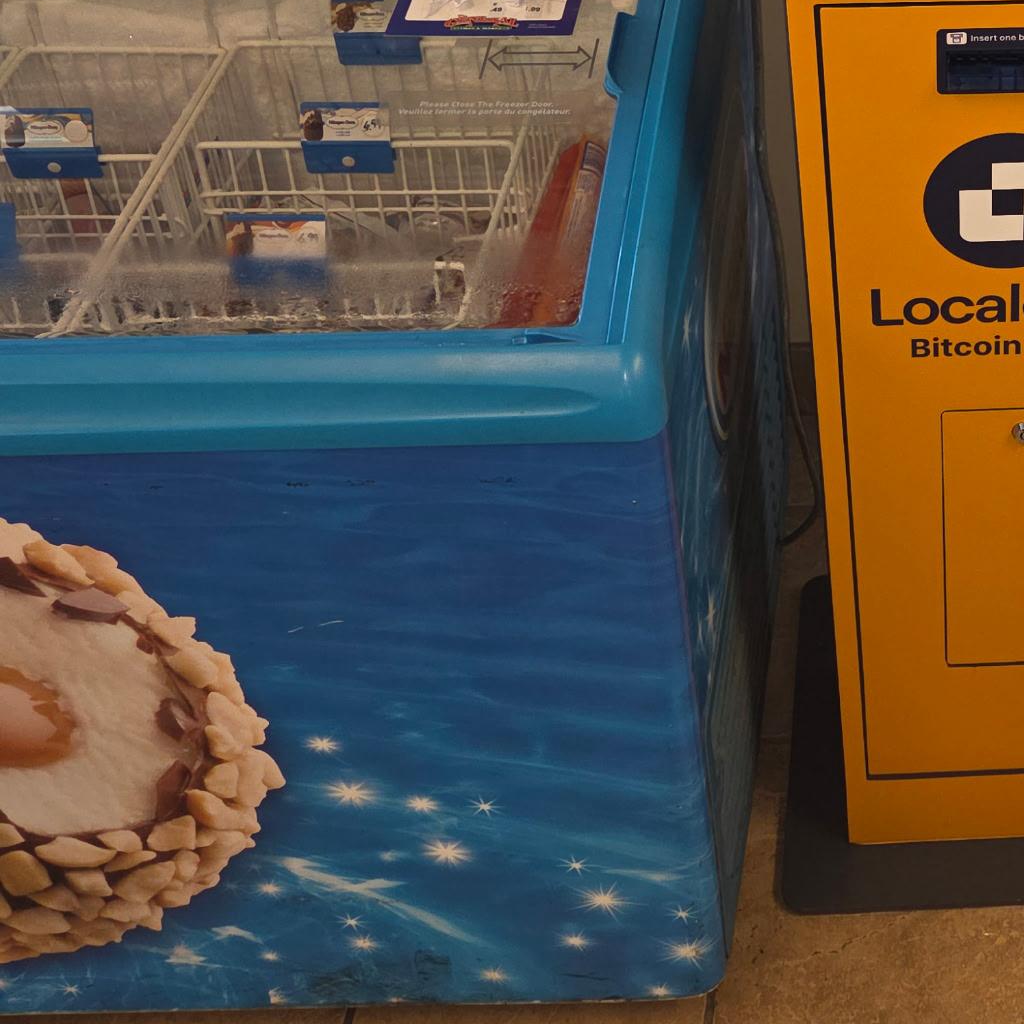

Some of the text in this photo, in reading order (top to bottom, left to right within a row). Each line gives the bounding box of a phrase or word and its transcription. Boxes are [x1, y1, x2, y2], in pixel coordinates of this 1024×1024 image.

[970, 33, 997, 43] Insert
[999, 34, 1017, 42] one
[451, 100, 475, 108] Close
[477, 100, 493, 108] The
[495, 100, 530, 108] Freezer
[531, 100, 554, 108] Door.
[911, 334, 1022, 358] Bitcoin
